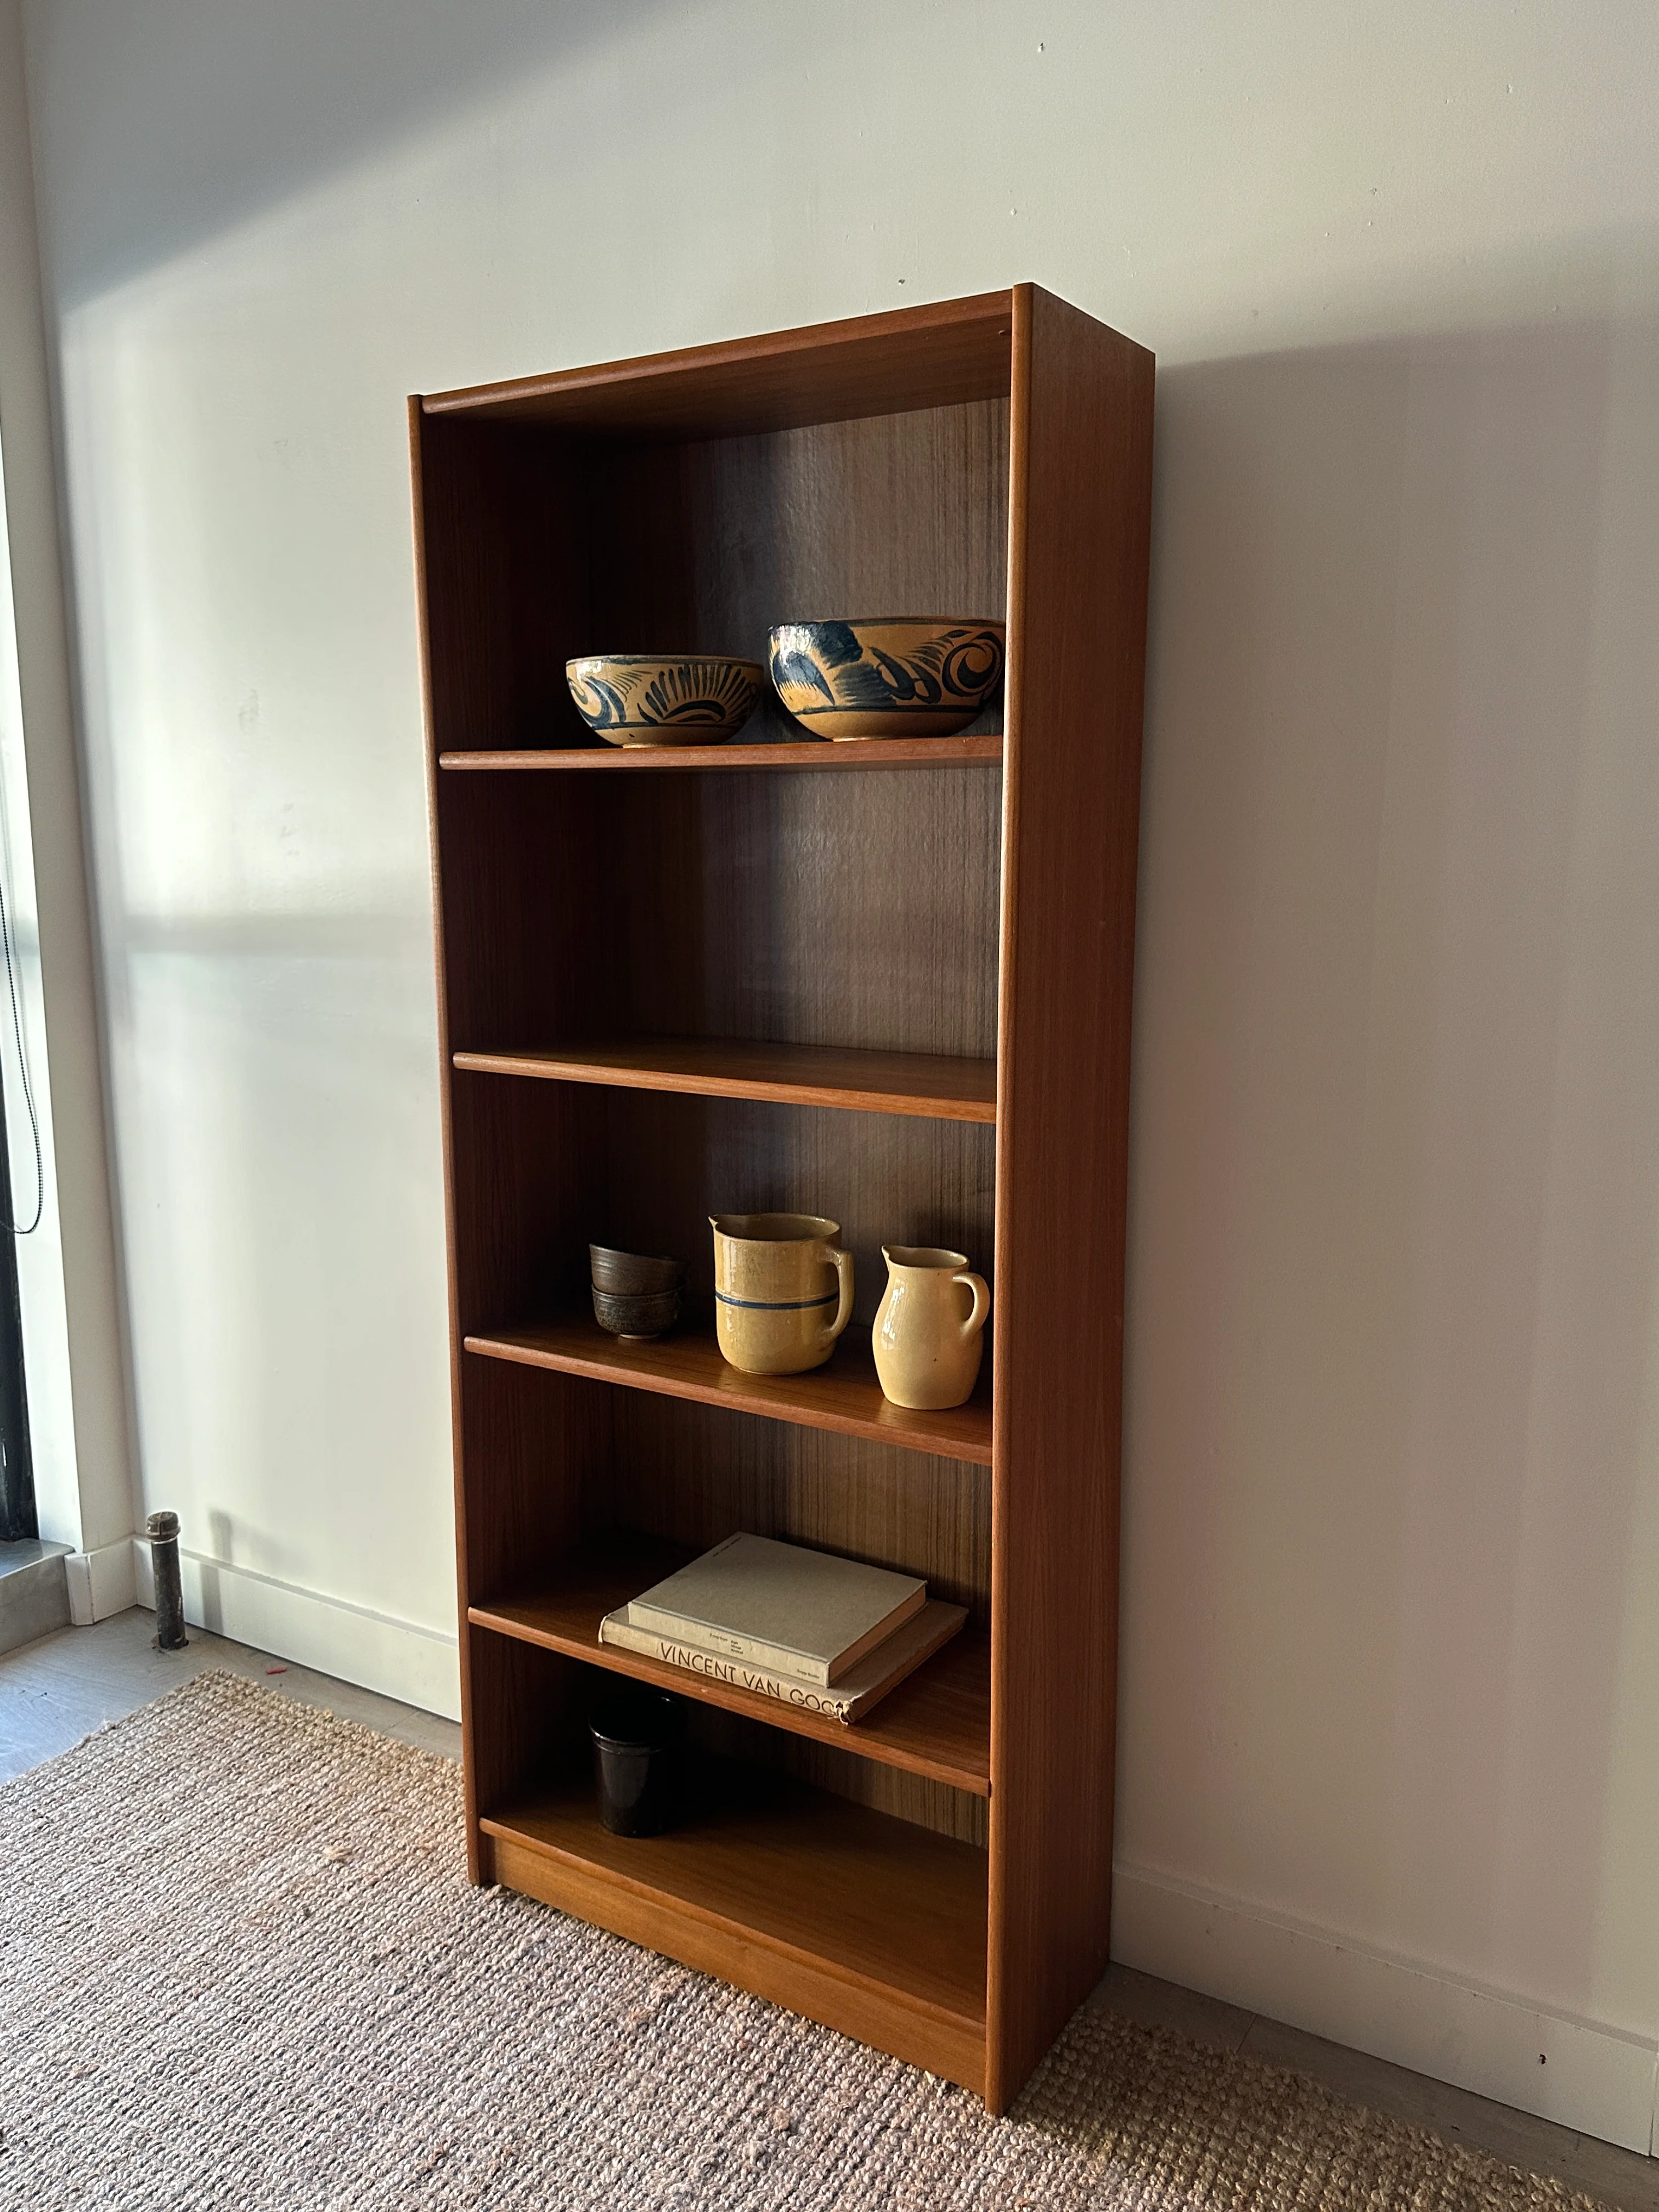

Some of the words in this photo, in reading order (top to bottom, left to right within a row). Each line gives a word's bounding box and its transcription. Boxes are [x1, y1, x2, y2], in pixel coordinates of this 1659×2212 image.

[661, 1642, 736, 1683] VINCENT
[743, 1671, 780, 1698] VAN
[789, 1689, 838, 1716] GOG
